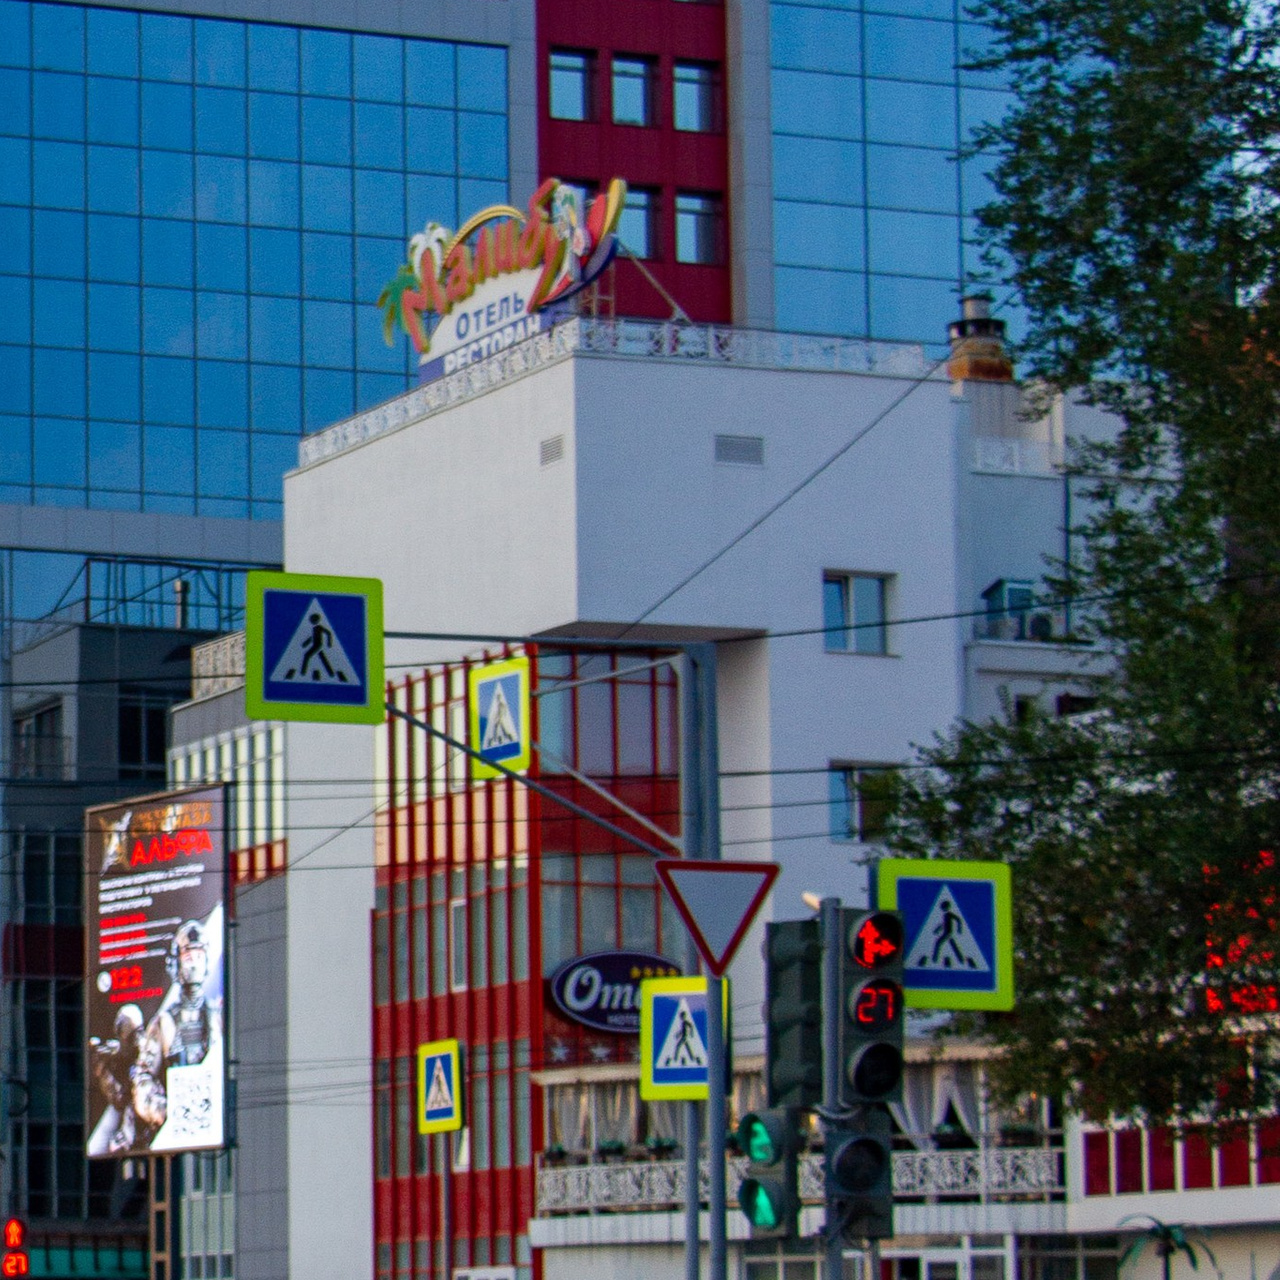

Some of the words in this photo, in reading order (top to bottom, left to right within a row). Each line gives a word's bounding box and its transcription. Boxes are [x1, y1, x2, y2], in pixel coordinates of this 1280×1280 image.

[456, 292, 524, 340] ОТЕЛЬ
[444, 315, 541, 374] РЕСТОРАН
[130, 828, 213, 868] АЛЬФА
[857, 987, 894, 1023] 27
[4, 1252, 29, 1276] 27
